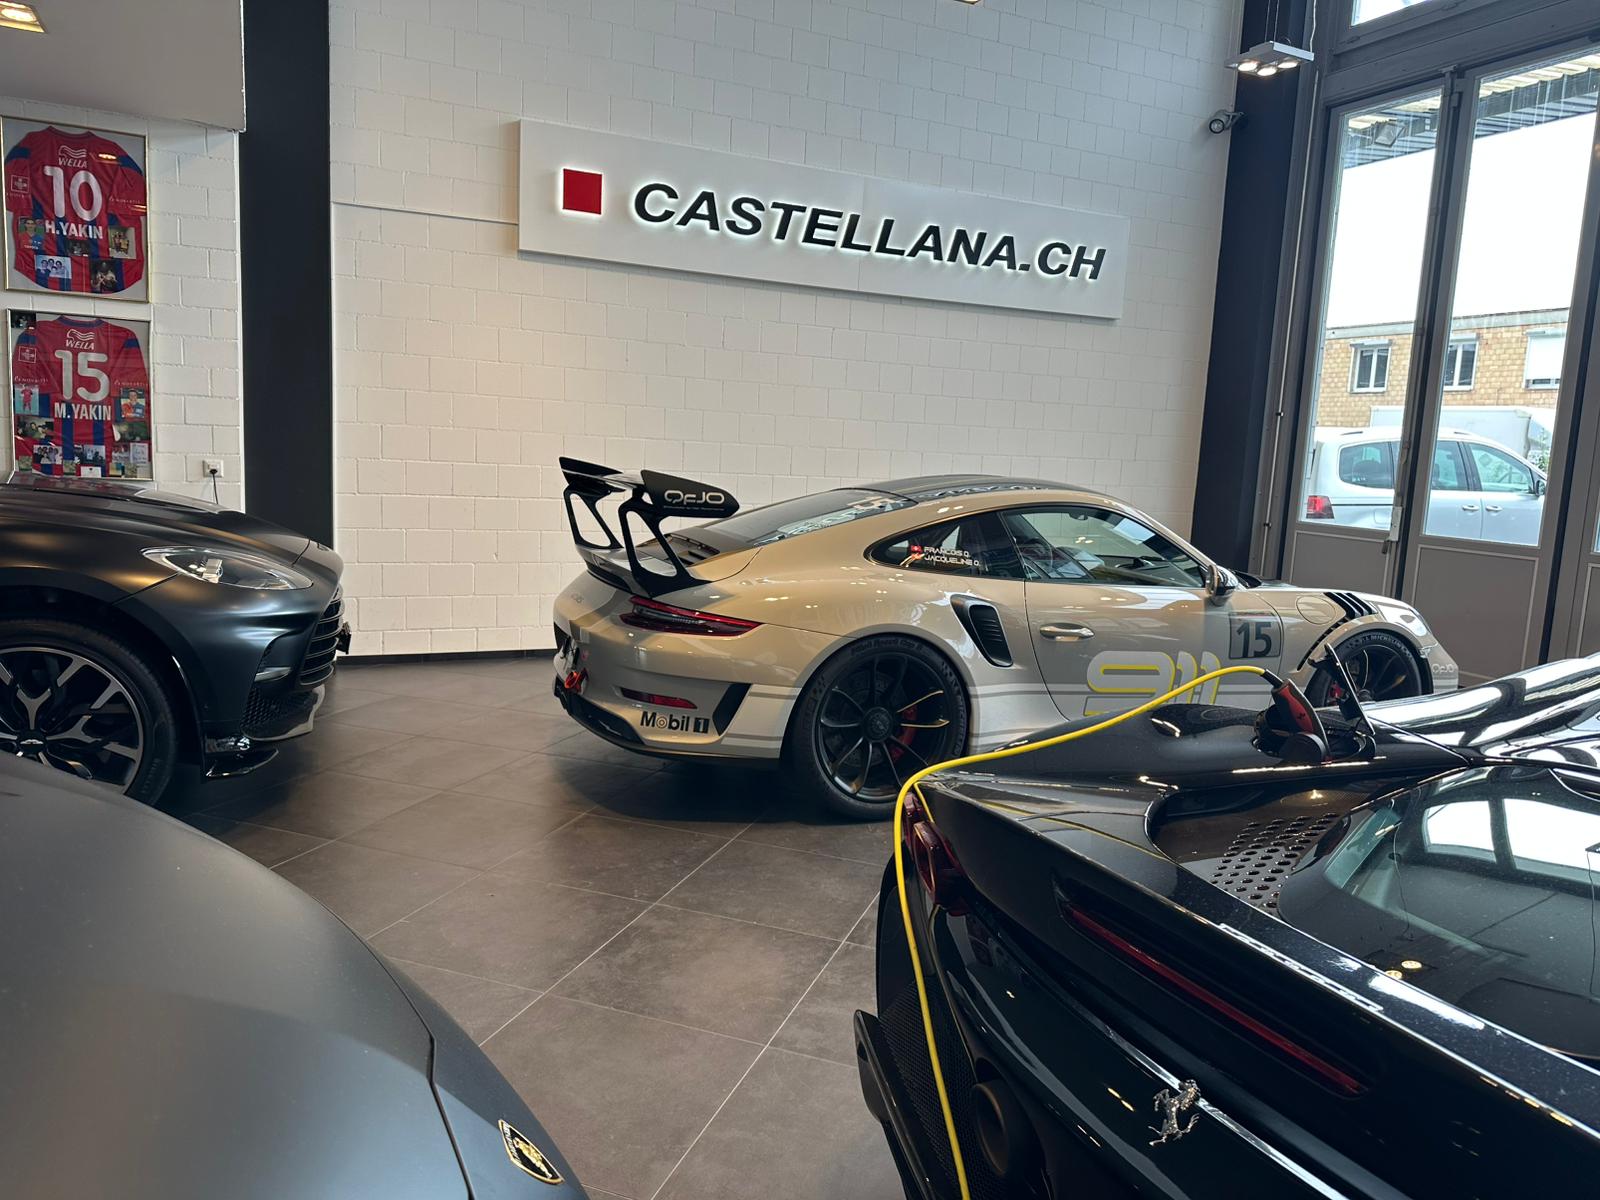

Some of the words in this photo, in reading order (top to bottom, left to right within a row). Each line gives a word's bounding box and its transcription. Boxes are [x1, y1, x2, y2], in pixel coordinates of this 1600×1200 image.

[58, 157, 88, 168] WELLA
[43, 165, 103, 222] 10
[634, 183, 1107, 281] CASTELLANA.CH
[65, 338, 95, 351] WELLA
[54, 349, 110, 402] 15
[924, 555, 973, 565] JACQUELINE
[1236, 621, 1272, 657] 15
[1083, 650, 1221, 716] 911
[640, 711, 690, 732] Mobil
